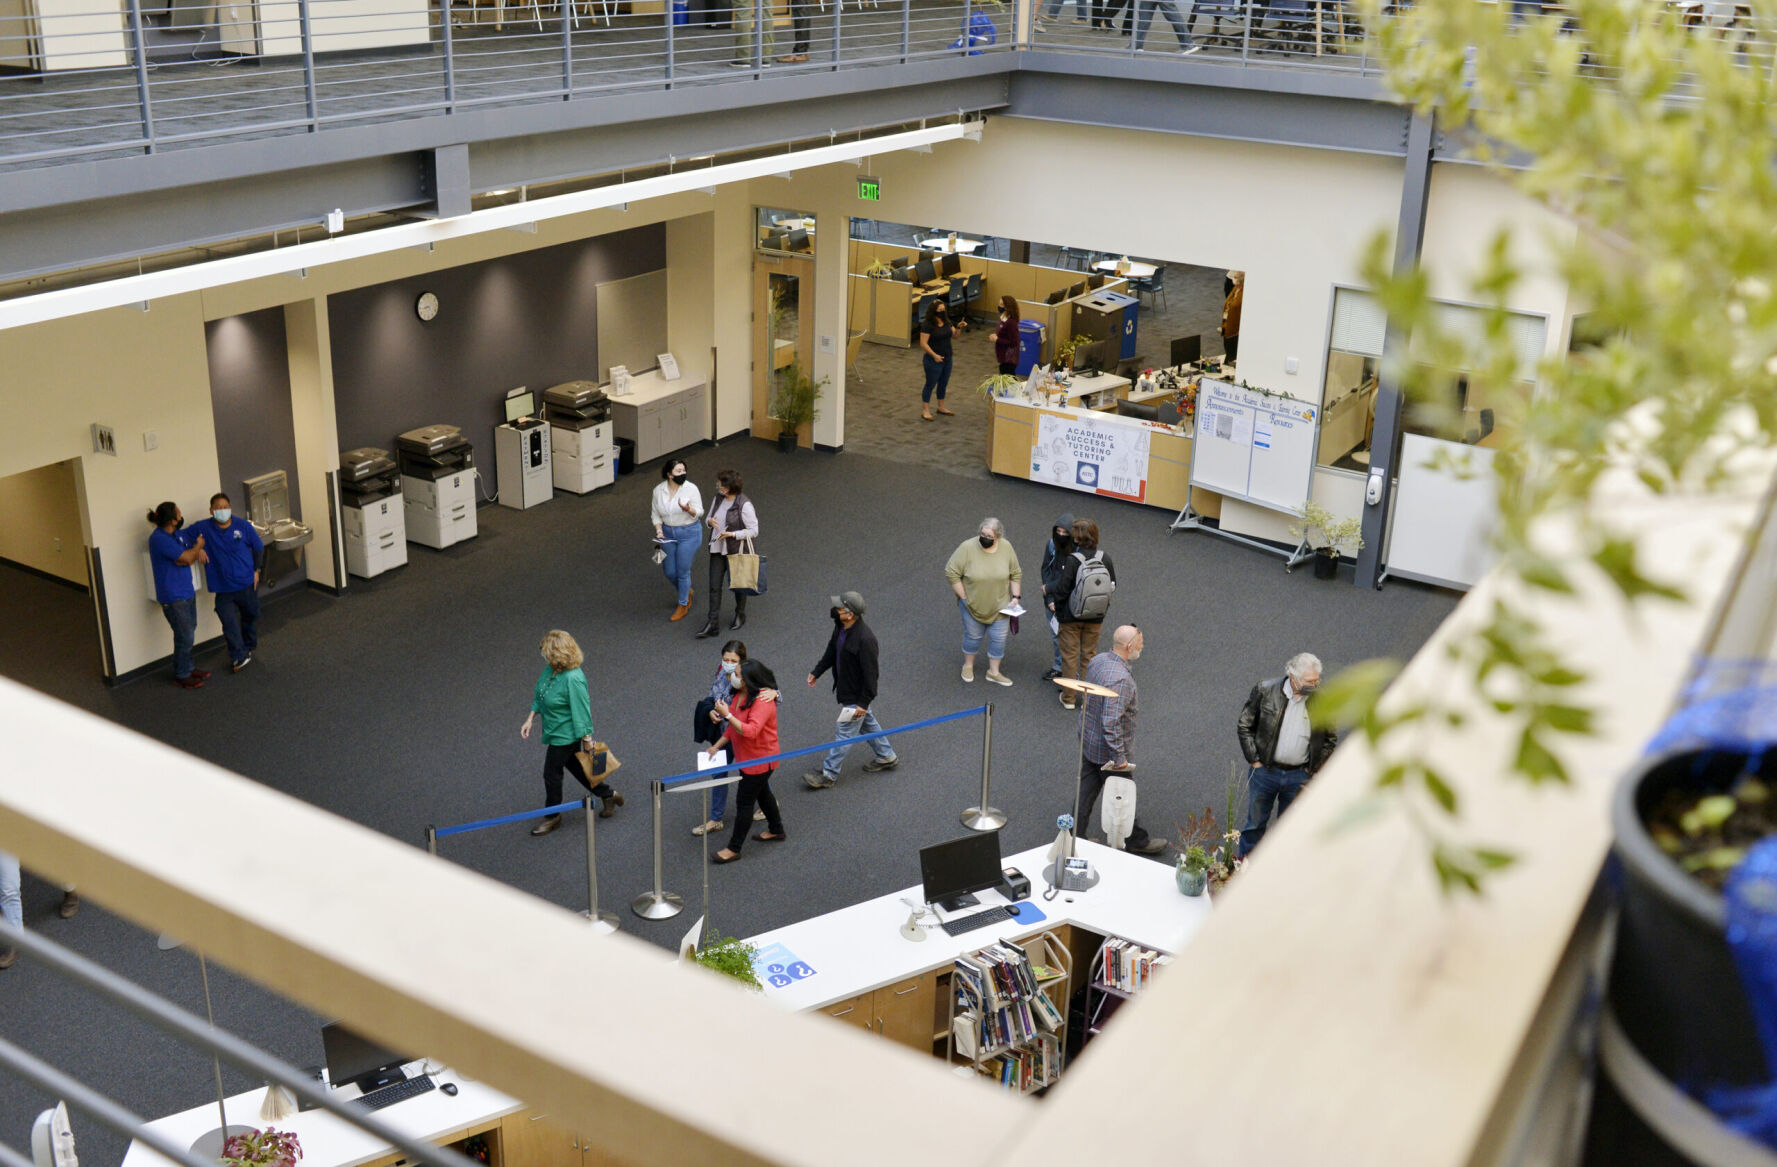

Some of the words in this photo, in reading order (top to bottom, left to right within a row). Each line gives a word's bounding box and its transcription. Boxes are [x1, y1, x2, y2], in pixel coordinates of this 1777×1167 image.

[861, 182, 878, 200] EXIT
[1065, 434, 1106, 448] SUCCESS
[1067, 427, 1114, 441] ACADEMIC
[1068, 442, 1112, 456] TUTORING
[1073, 450, 1105, 462] CENTER
